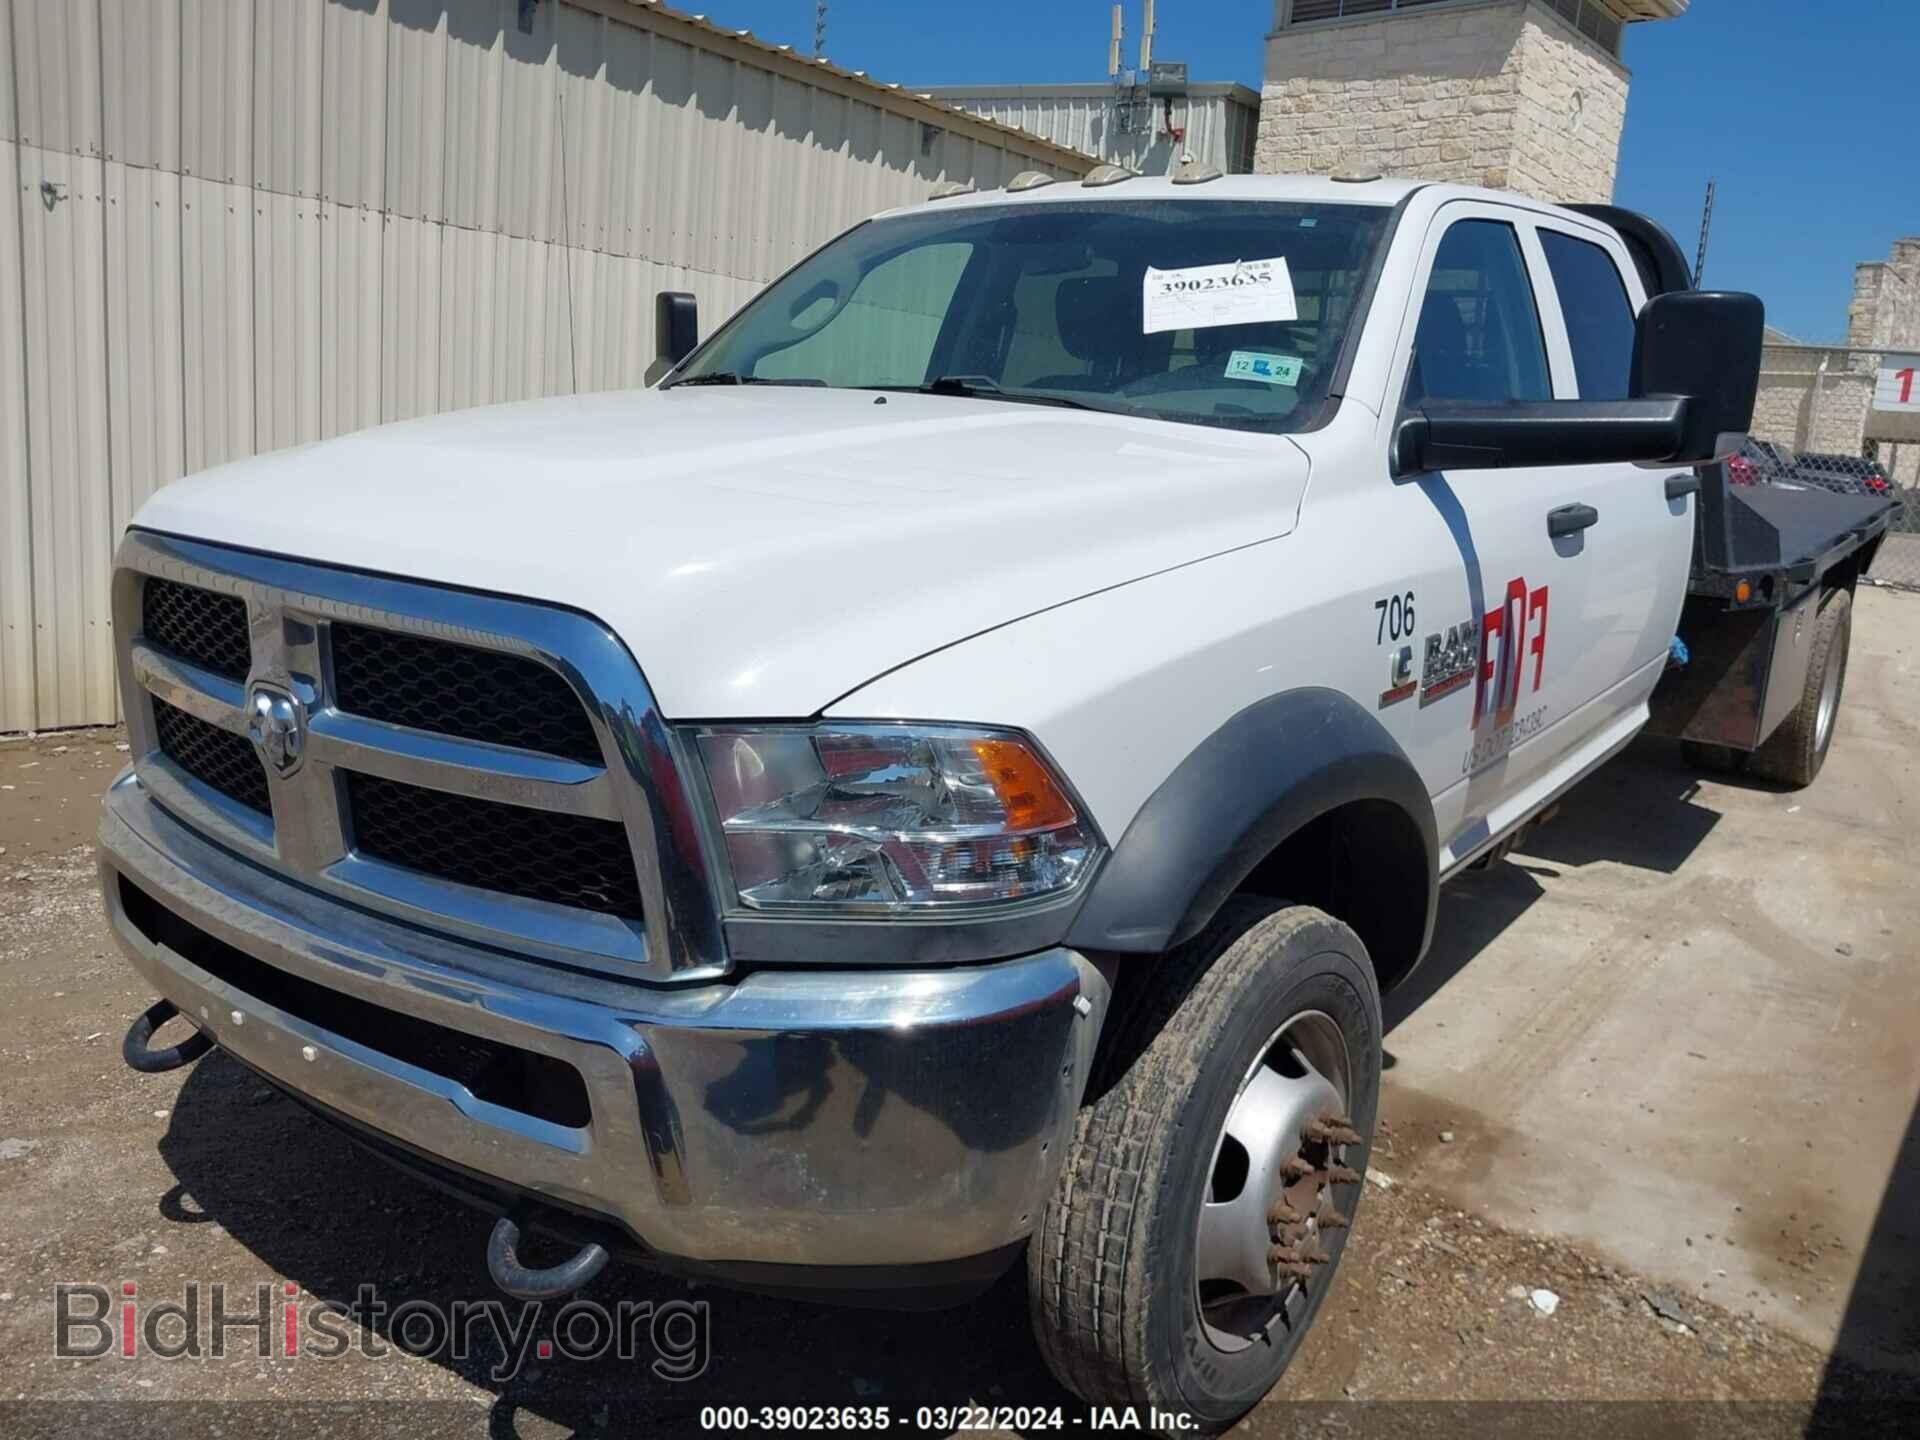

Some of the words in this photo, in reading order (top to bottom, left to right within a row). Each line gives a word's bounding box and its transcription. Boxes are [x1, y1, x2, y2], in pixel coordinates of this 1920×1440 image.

[1161, 272, 1272, 294] 39023635
[1236, 360, 1249, 370] 12
[1275, 366, 1290, 377] 24
[1895, 368, 1914, 403] 1
[1374, 590, 1416, 646] 706
